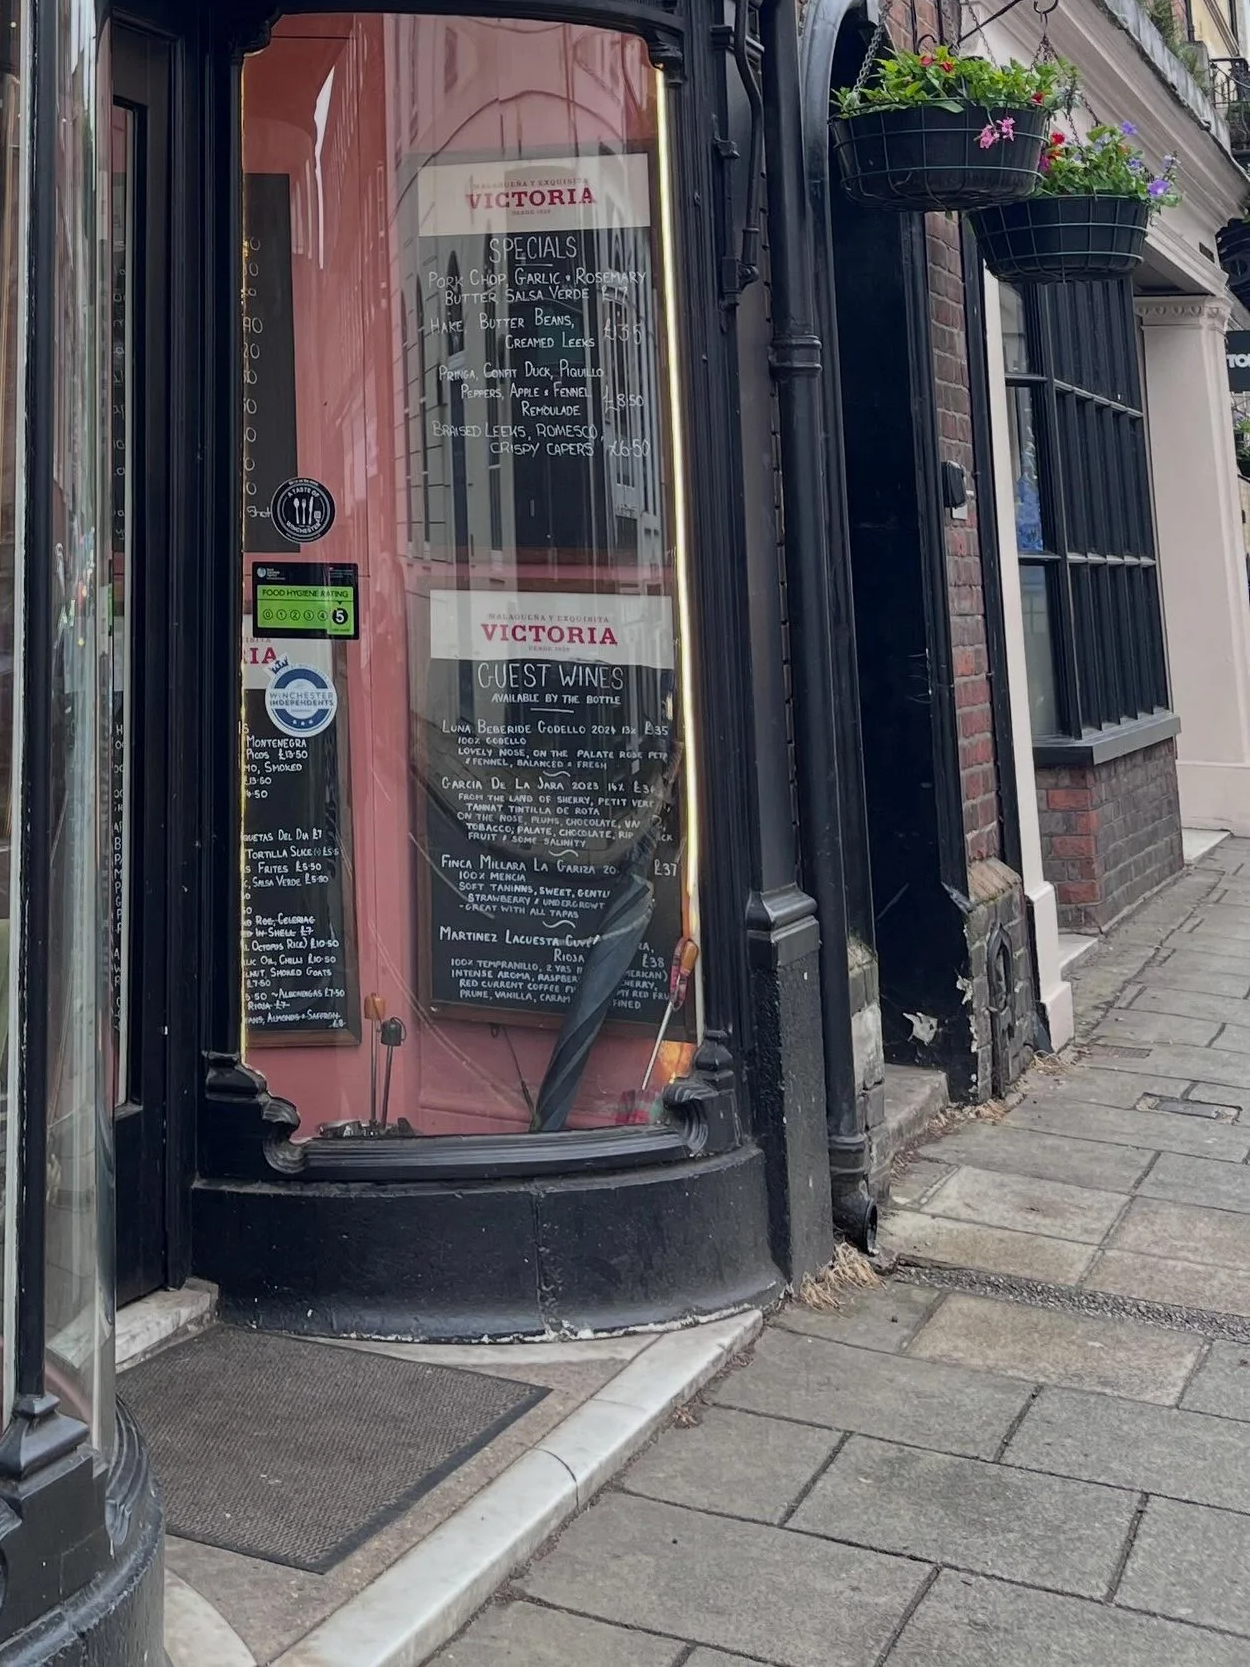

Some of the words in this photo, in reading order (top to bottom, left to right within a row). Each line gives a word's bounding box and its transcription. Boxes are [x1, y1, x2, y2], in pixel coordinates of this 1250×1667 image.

[465, 187, 596, 210] VICTORIA
[489, 236, 577, 263] SPECIALS
[429, 271, 464, 289] PORK
[514, 267, 561, 285] GARLIC
[575, 267, 647, 284] ROSEMARY
[506, 288, 544, 302] SALSA
[550, 285, 590, 300] VERDE
[479, 313, 525, 330] BUTTER
[534, 308, 575, 329] BEANS,
[505, 335, 555, 349] CREAMED
[562, 331, 595, 348] LEEKS
[525, 360, 554, 380] DUCK,
[559, 359, 604, 378] PIQUILLO
[461, 384, 504, 401] PEPPERS,
[510, 383, 539, 398] APPLE
[553, 381, 590, 398] FENNEL
[522, 400, 581, 416] REMOULADE
[431, 420, 481, 438] BRAISED
[485, 422, 531, 440] LEEKS,
[490, 443, 540, 458] CRISPY
[546, 443, 594, 456] CAPERS
[286, 589, 319, 597] HYGIENE
[320, 590, 349, 598] RATING
[335, 610, 344, 623] 5
[481, 624, 618, 646] VICTORIA
[478, 662, 551, 688] GUEST
[559, 665, 624, 690] WINES
[269, 691, 334, 700] WINCHESTER
[491, 693, 539, 704] AVAILABLE
[545, 694, 559, 704] BY
[562, 695, 580, 704] THE
[586, 695, 622, 705] BOTTLE
[269, 699, 334, 707] INDEPENDENTS
[442, 720, 471, 734] LUNA
[477, 719, 532, 734] BEBERIDE
[538, 721, 586, 734] GODELLO
[246, 735, 307, 749] MONTENEGRA
[485, 737, 526, 745] GODELLO
[458, 747, 493, 757] LOVELY
[500, 749, 530, 758] NOSE,
[577, 750, 614, 759] PALATE
[264, 761, 303, 773] SMOKED
[517, 759, 563, 768] BALANCED
[577, 761, 607, 770] FRESH
[441, 777, 482, 789] GARCIA
[491, 776, 507, 789] DE
[515, 778, 530, 789] LA
[537, 777, 564, 790] JARA
[572, 782, 599, 791] 2023
[458, 793, 483, 801] FROM
[487, 794, 505, 802] THE
[508, 794, 533, 803] LAND
[557, 796, 594, 806] SHERRY,
[598, 798, 627, 807] PETIT
[467, 803, 503, 812] TANNAT
[508, 805, 551, 814] TINTILLA
[556, 806, 570, 814] DE
[575, 807, 600, 815] ROTA
[457, 812, 473, 820] ON
[476, 813, 495, 822] THE
[499, 815, 527, 824] NOSE,
[565, 817, 622, 828] CHOCOLATE,
[278, 829, 292, 841] DEL
[517, 826, 556, 836] PALATE,
[559, 828, 616, 839] CHOCOLATE,
[468, 832, 497, 841] FRUIT
[512, 835, 537, 844] SOME
[544, 837, 586, 848] SALINITY
[245, 849, 288, 859] TORTILLA
[290, 845, 312, 857] SLICE
[258, 861, 289, 874] FRITES
[441, 854, 472, 870] FINCA
[480, 855, 526, 871] MILLARA
[533, 858, 549, 872] LA
[556, 859, 595, 874] GARIZA
[654, 859, 678, 877] £37
[252, 876, 274, 887] SALSA
[276, 874, 302, 886] VERDE
[459, 871, 485, 881] 100%
[490, 872, 526, 882] MENCIA
[459, 882, 485, 891] SOFT
[539, 887, 575, 898] SWEET,
[468, 894, 531, 905] STRAWBERRY
[543, 897, 605, 910] UNDERGROWT
[500, 905, 526, 914] WITH
[529, 907, 546, 917] ALL
[549, 909, 580, 919] TAPAS
[439, 926, 498, 942] MARTINEZ
[505, 929, 560, 946] LACUESTA
[451, 958, 474, 966] 100%
[477, 959, 543, 972] TEMPRANILLO,
[554, 949, 586, 963] RIOJA
[642, 955, 665, 968] £38
[270, 967, 302, 977] SMOKED
[306, 967, 332, 976] GOATS
[451, 969, 494, 978] INTENSE
[497, 971, 534, 982] AROMA,
[459, 978, 479, 987] RED
[481, 980, 523, 990] CURRENT
[527, 982, 560, 992] COFFEE
[459, 990, 492, 1001] PRUNE,
[495, 992, 537, 1003] VANILLA,
